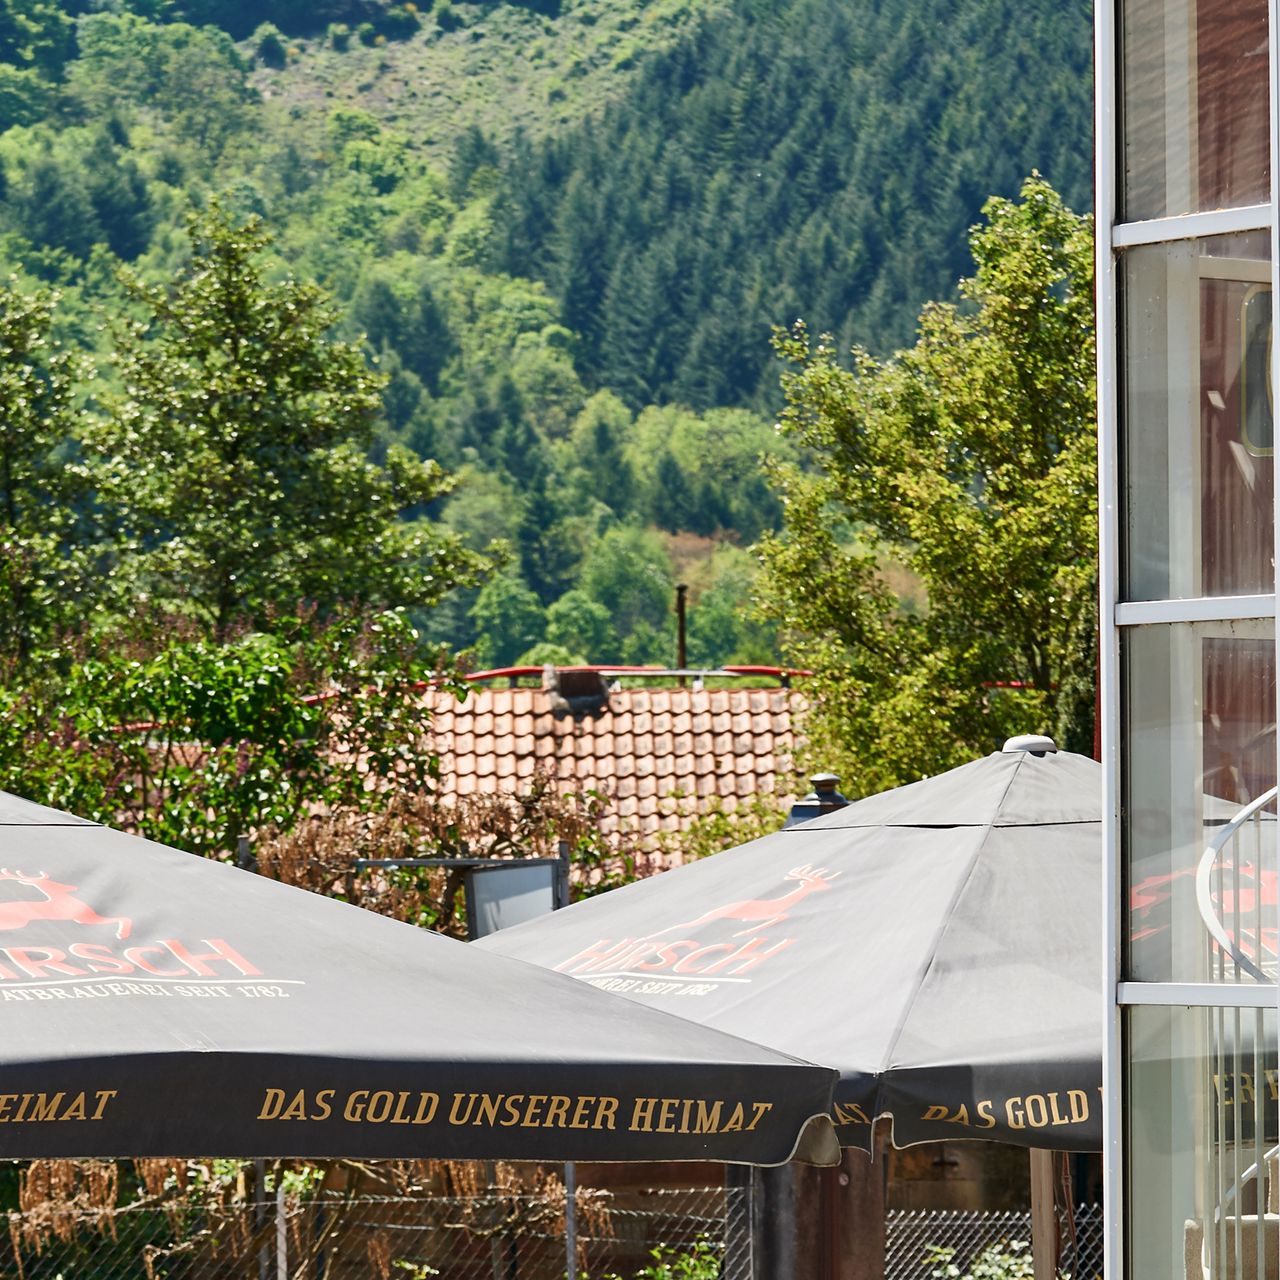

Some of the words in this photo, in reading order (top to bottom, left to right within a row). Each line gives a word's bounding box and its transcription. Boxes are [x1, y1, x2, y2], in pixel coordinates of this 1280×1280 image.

[552, 937, 797, 975] HIRSCH
[175, 985, 233, 999] SEIT
[235, 985, 290, 999] 1782
[637, 980, 679, 996] SEIT
[256, 1087, 335, 1121] DAS
[343, 1090, 440, 1126] GOLD
[448, 1093, 619, 1131] UNSERER
[628, 1096, 773, 1134] HEIMAT
[920, 1100, 996, 1129] DAS
[1005, 1089, 1090, 1129] GOLD
